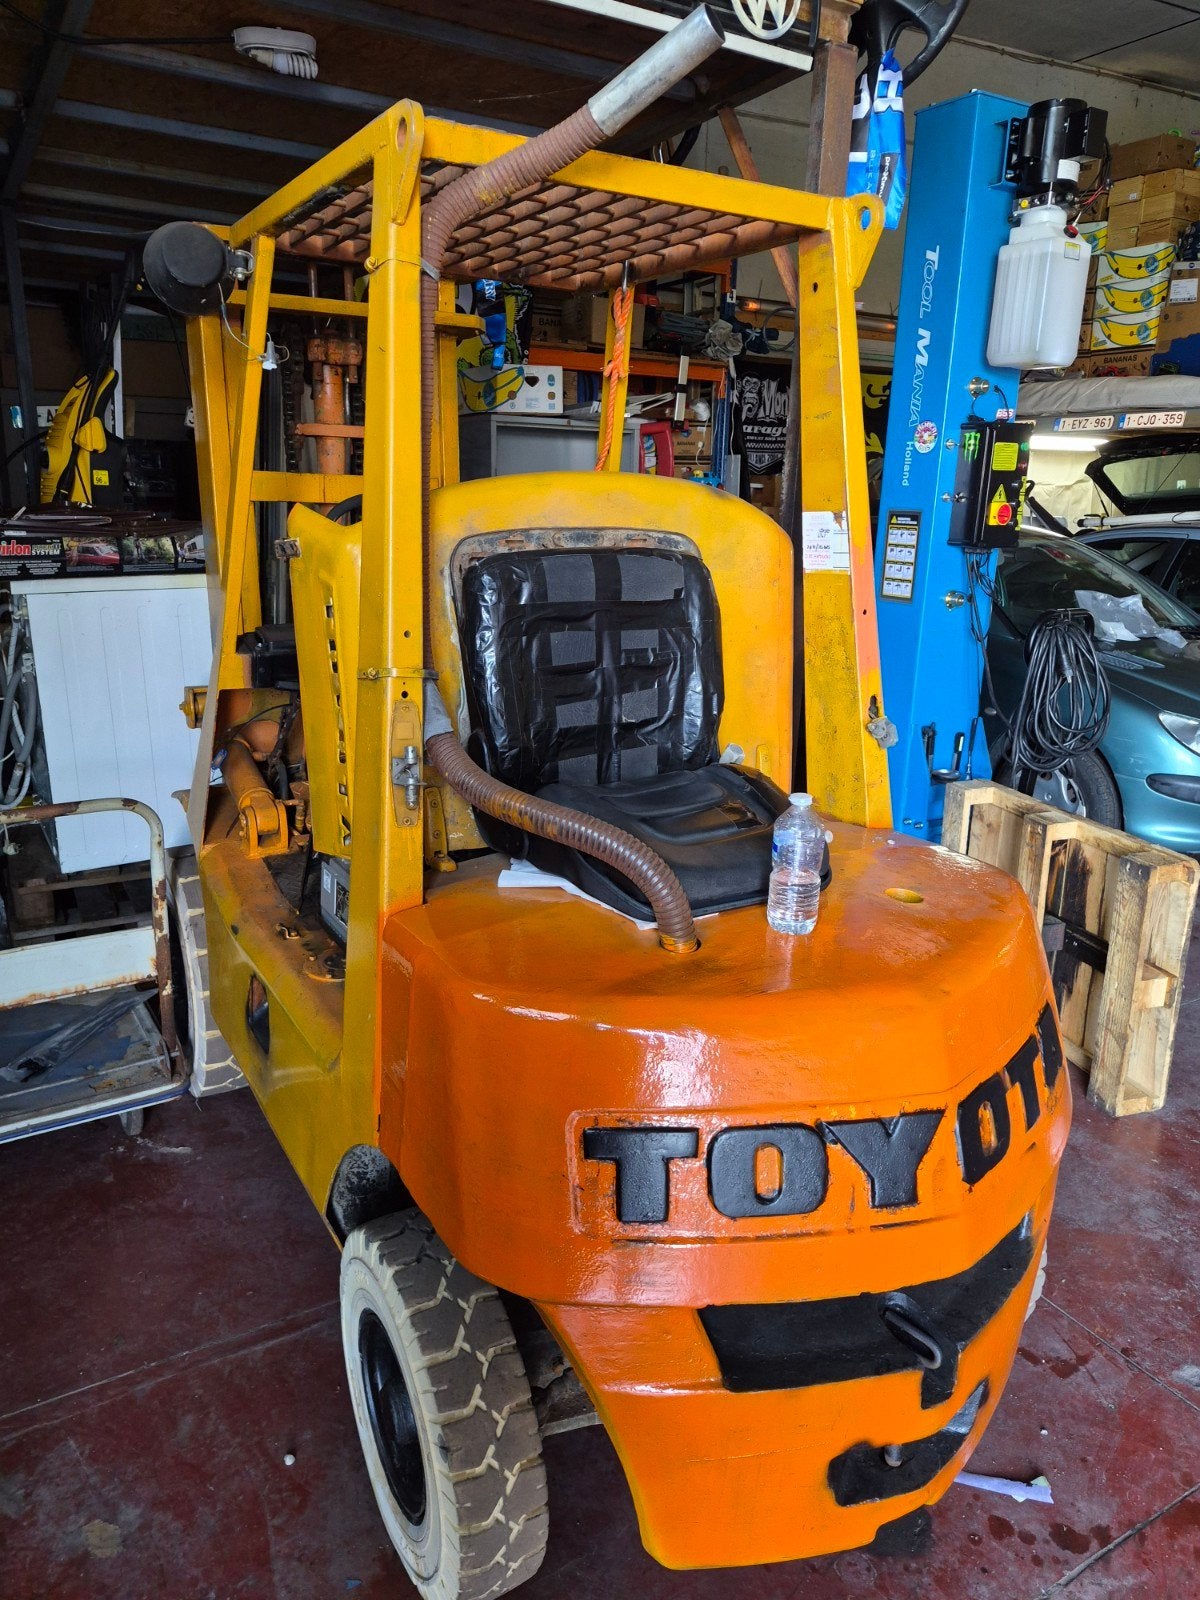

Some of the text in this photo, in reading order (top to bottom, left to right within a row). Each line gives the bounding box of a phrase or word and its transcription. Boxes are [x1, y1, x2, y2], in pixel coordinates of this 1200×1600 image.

[920, 245, 939, 318] TOOL
[909, 327, 931, 427] MANIA
[1103, 354, 1138, 363] BANANAS
[757, 379, 790, 421] Mon
[1061, 418, 1112, 430] 1-EYZ-961
[901, 441, 914, 487] Holland
[0, 540, 31, 556] irlon
